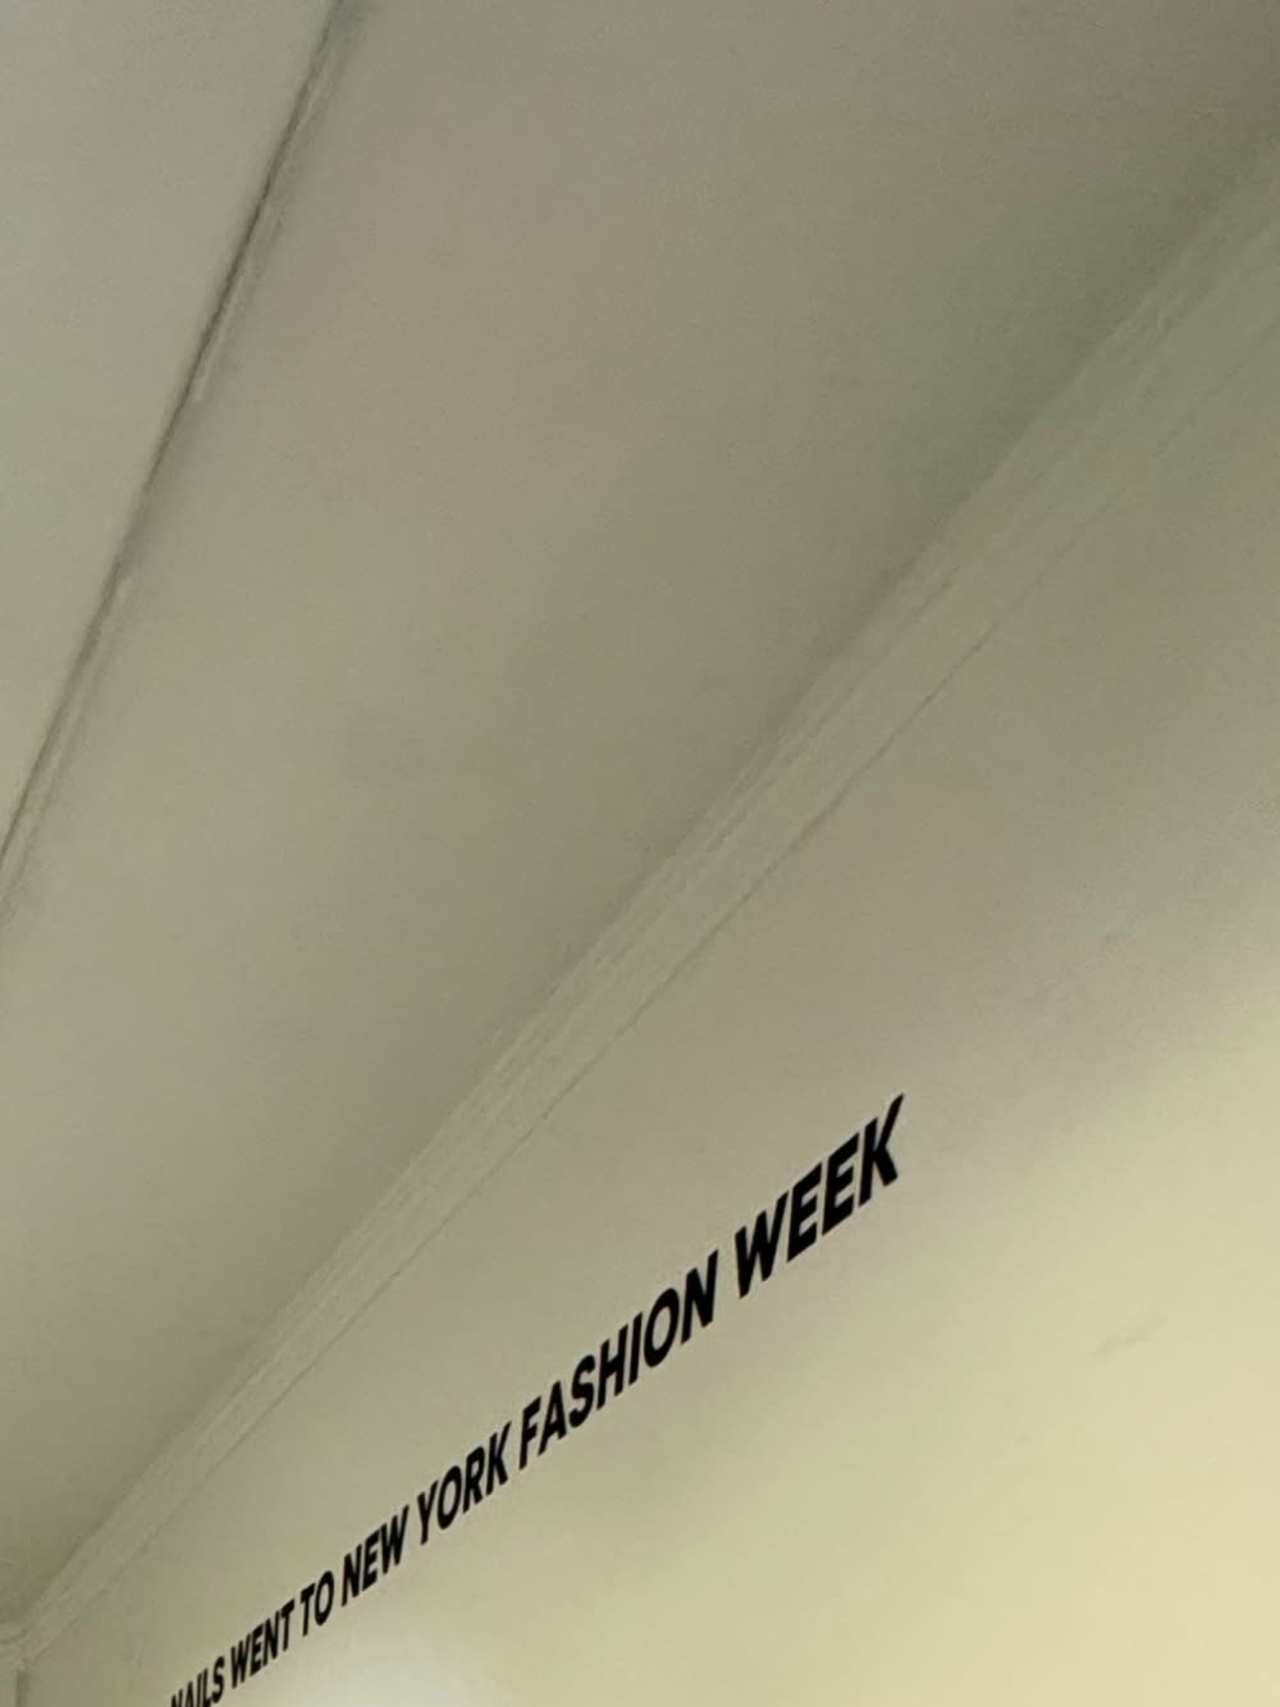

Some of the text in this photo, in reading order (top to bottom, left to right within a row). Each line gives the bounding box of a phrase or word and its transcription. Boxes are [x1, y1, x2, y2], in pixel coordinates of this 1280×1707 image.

[229, 1596, 295, 1691] WENT
[298, 1570, 334, 1638] TO
[340, 1504, 410, 1606] NEW
[416, 1420, 512, 1545] YORK
[517, 1248, 719, 1472] FASHION
[734, 1092, 905, 1300] WEEK
